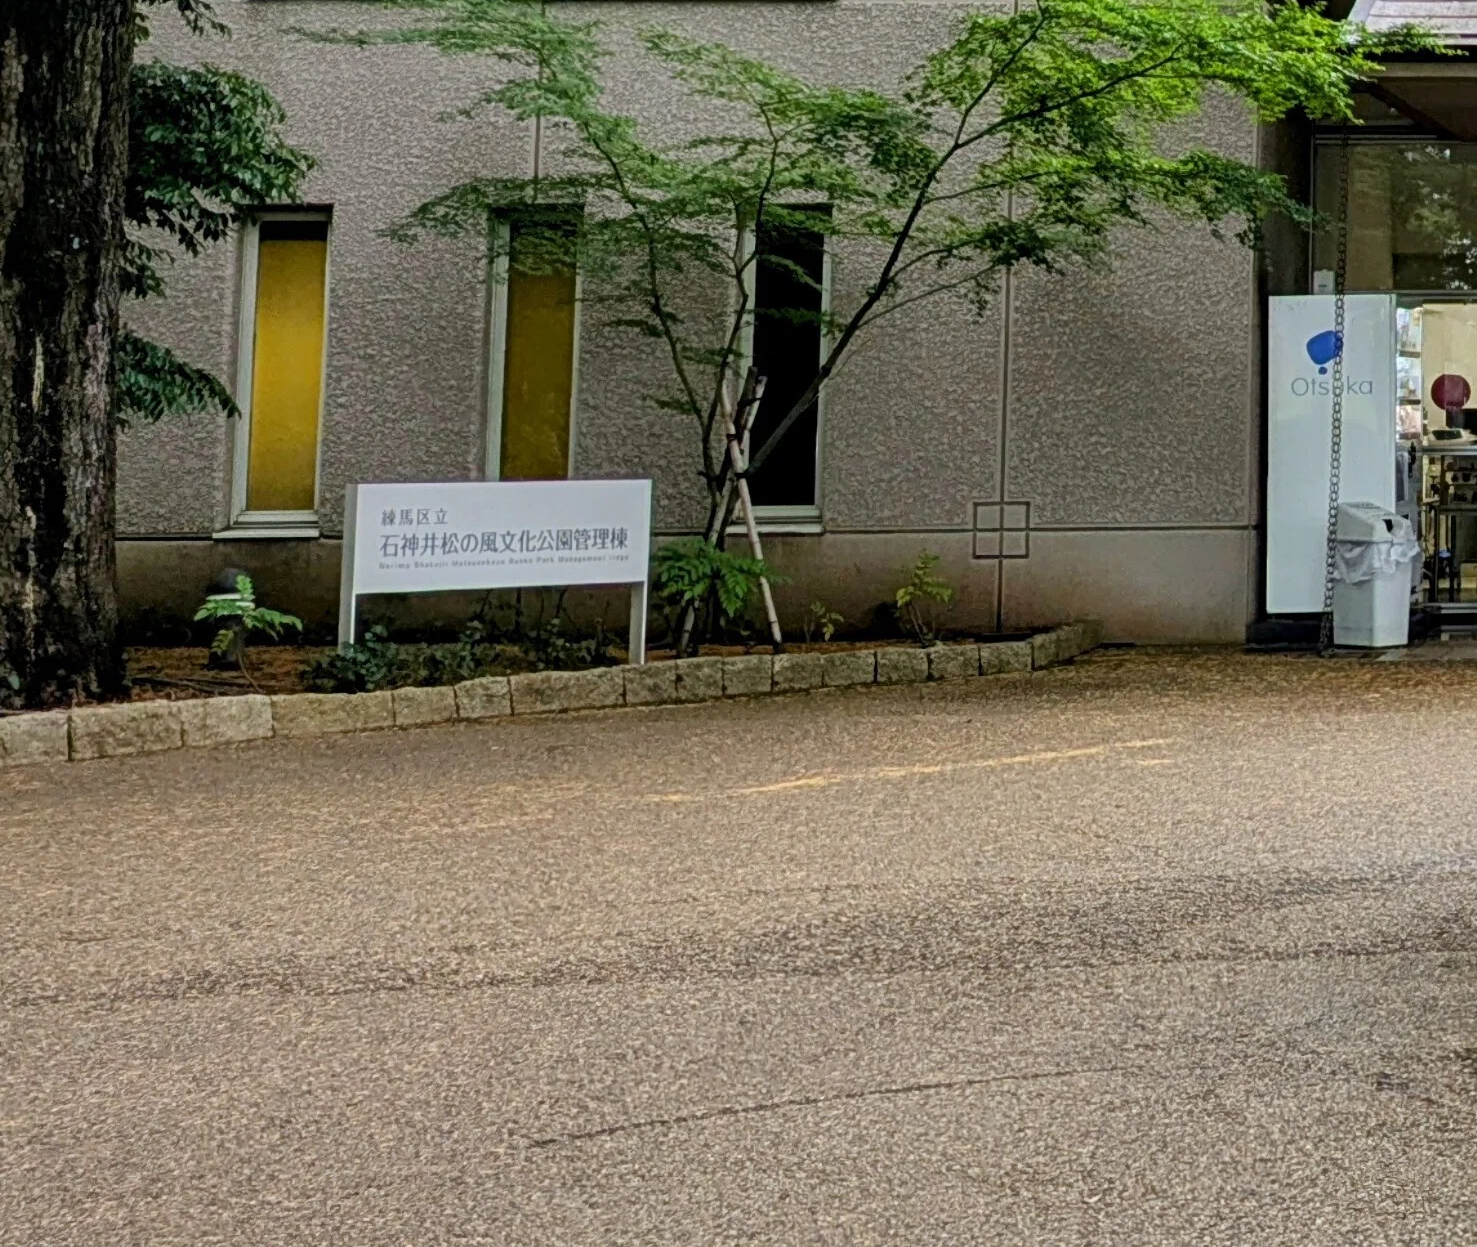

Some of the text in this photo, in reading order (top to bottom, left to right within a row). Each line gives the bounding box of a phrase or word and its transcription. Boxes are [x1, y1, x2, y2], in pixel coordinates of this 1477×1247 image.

[381, 507, 448, 526] 練馬区立
[379, 527, 628, 557] 石神井松の風文化公園管理棟
